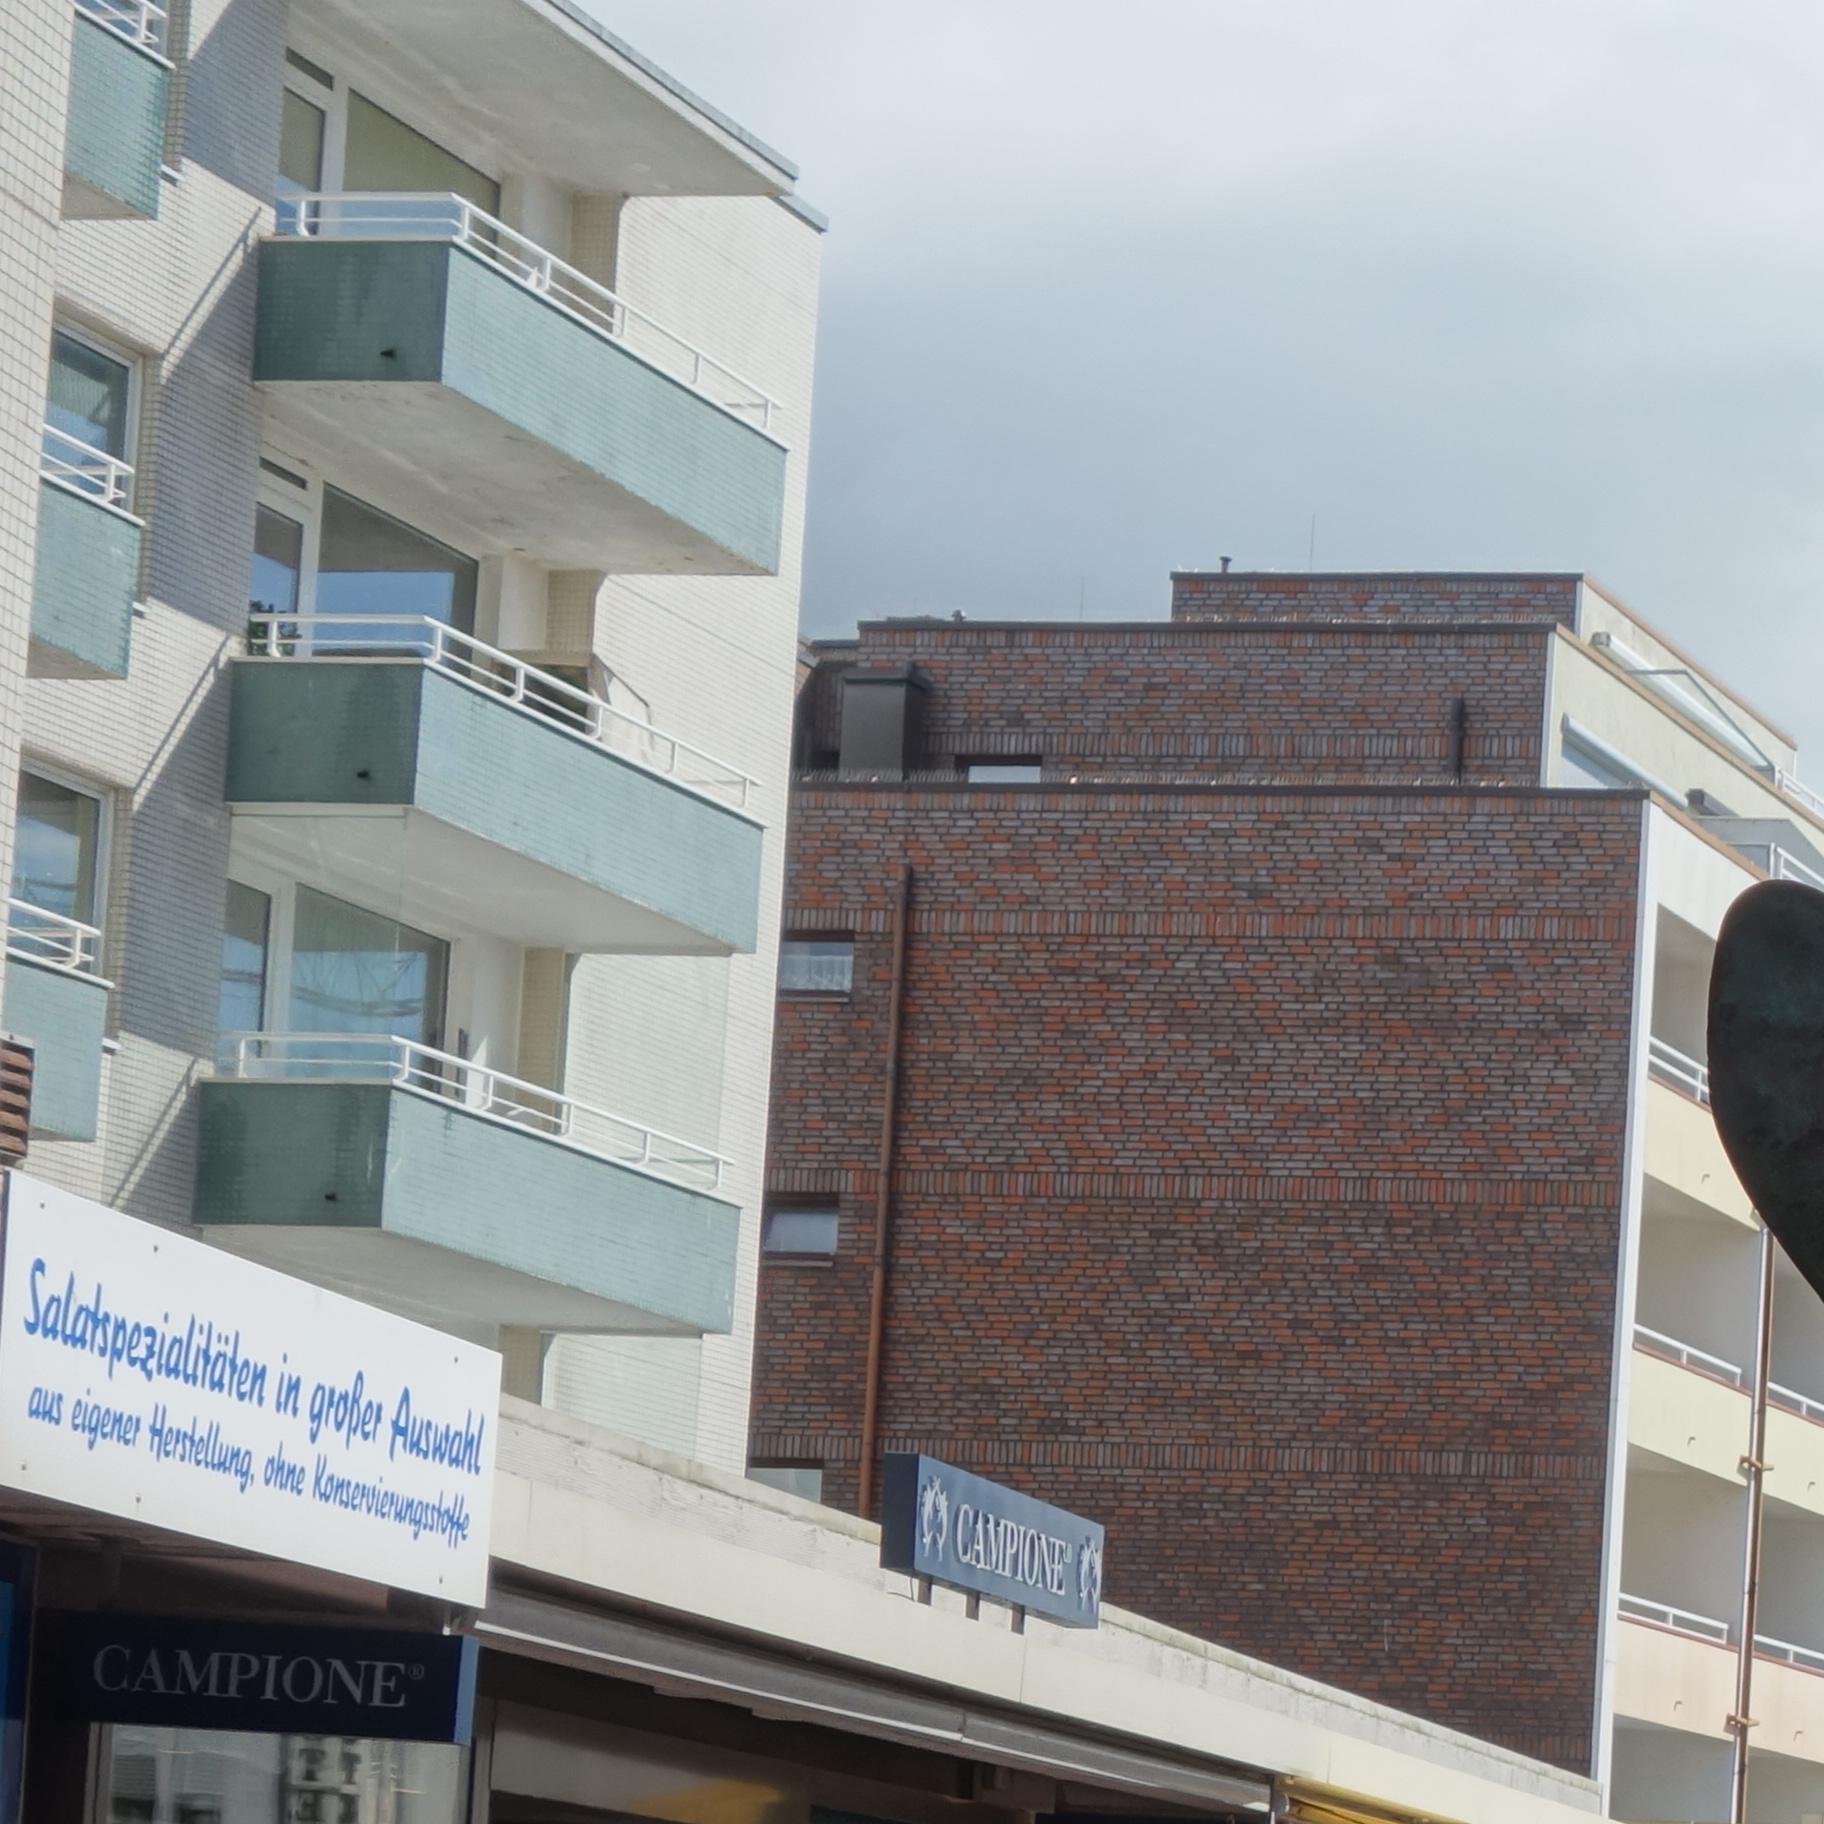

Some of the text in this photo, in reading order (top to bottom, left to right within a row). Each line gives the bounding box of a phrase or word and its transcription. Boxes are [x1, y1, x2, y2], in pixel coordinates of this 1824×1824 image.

[23, 1257, 487, 1477] Salatspezialitäten in großer Auswahl
[27, 1385, 470, 1550] aus eigener Herstellung, ohne Konservierungsstoffe
